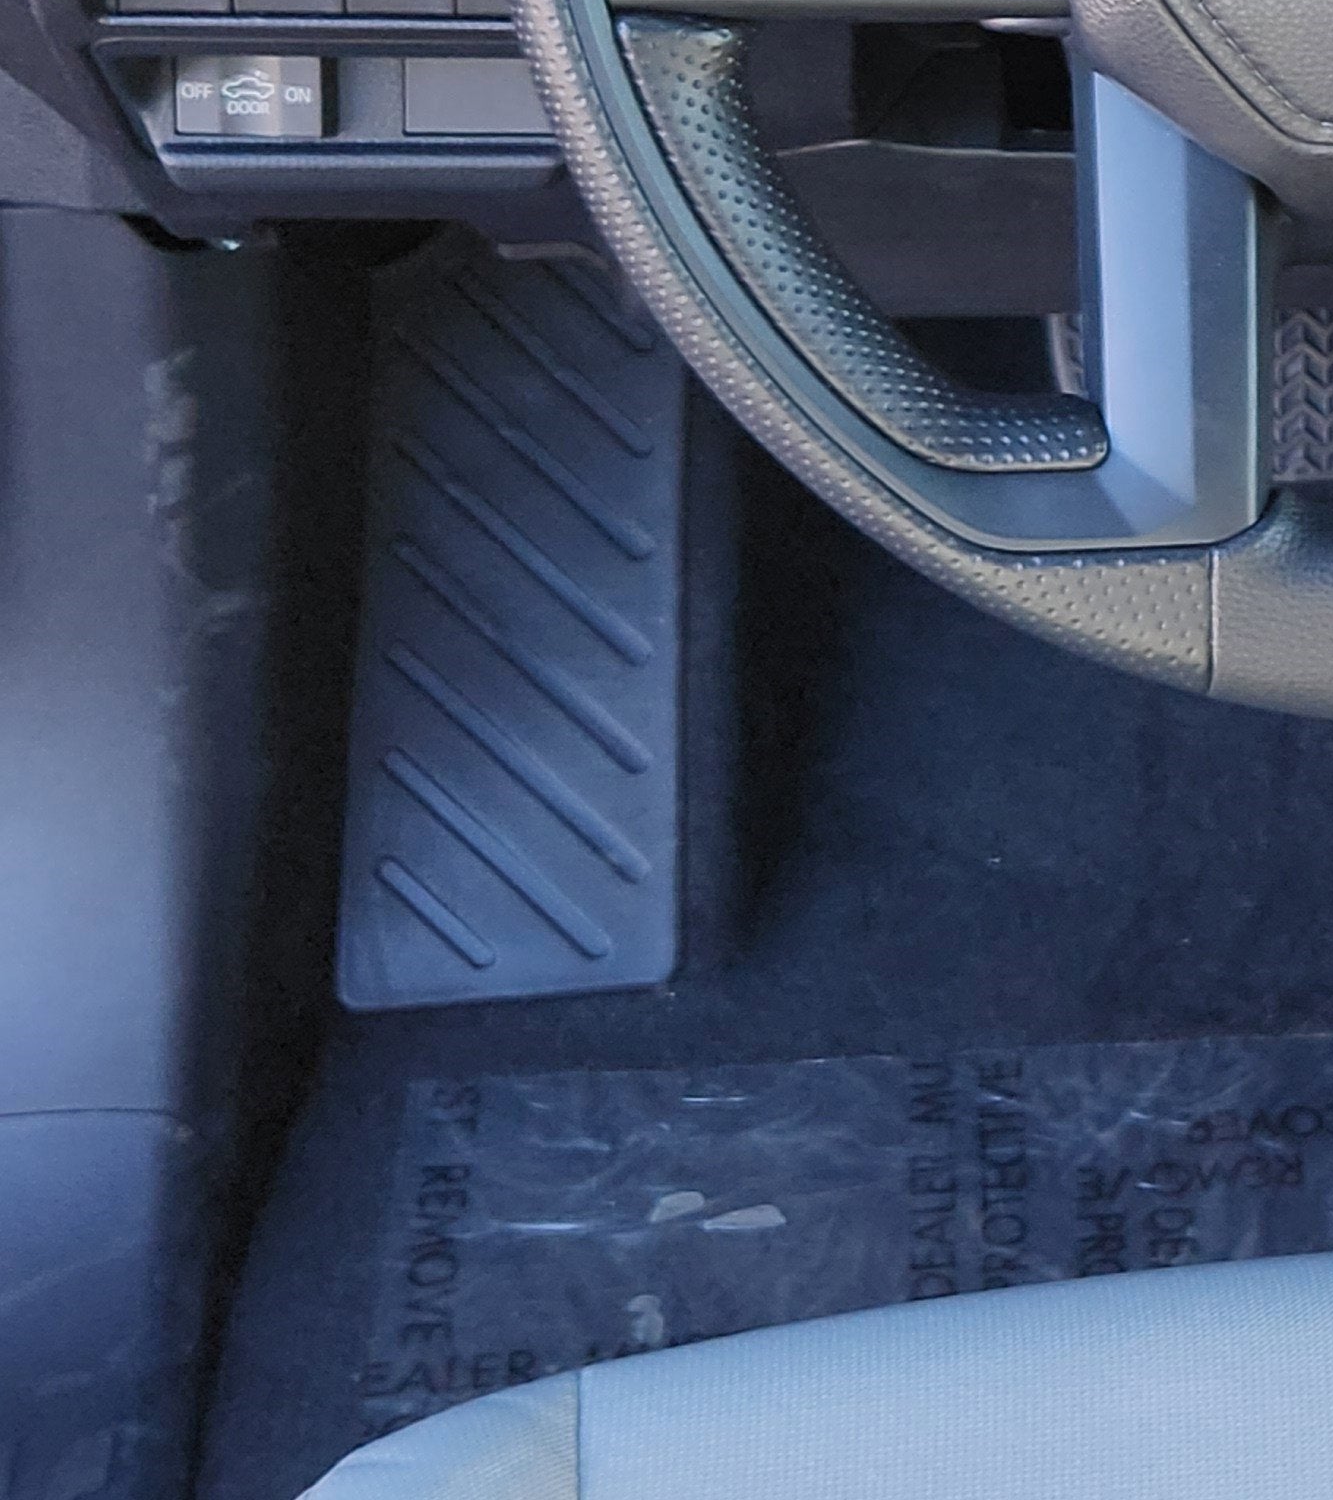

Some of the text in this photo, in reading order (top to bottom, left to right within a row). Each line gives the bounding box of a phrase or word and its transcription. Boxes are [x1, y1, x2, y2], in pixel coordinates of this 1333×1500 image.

[181, 82, 215, 99] OFF
[285, 87, 312, 104] ON
[226, 101, 270, 115] DOOR
